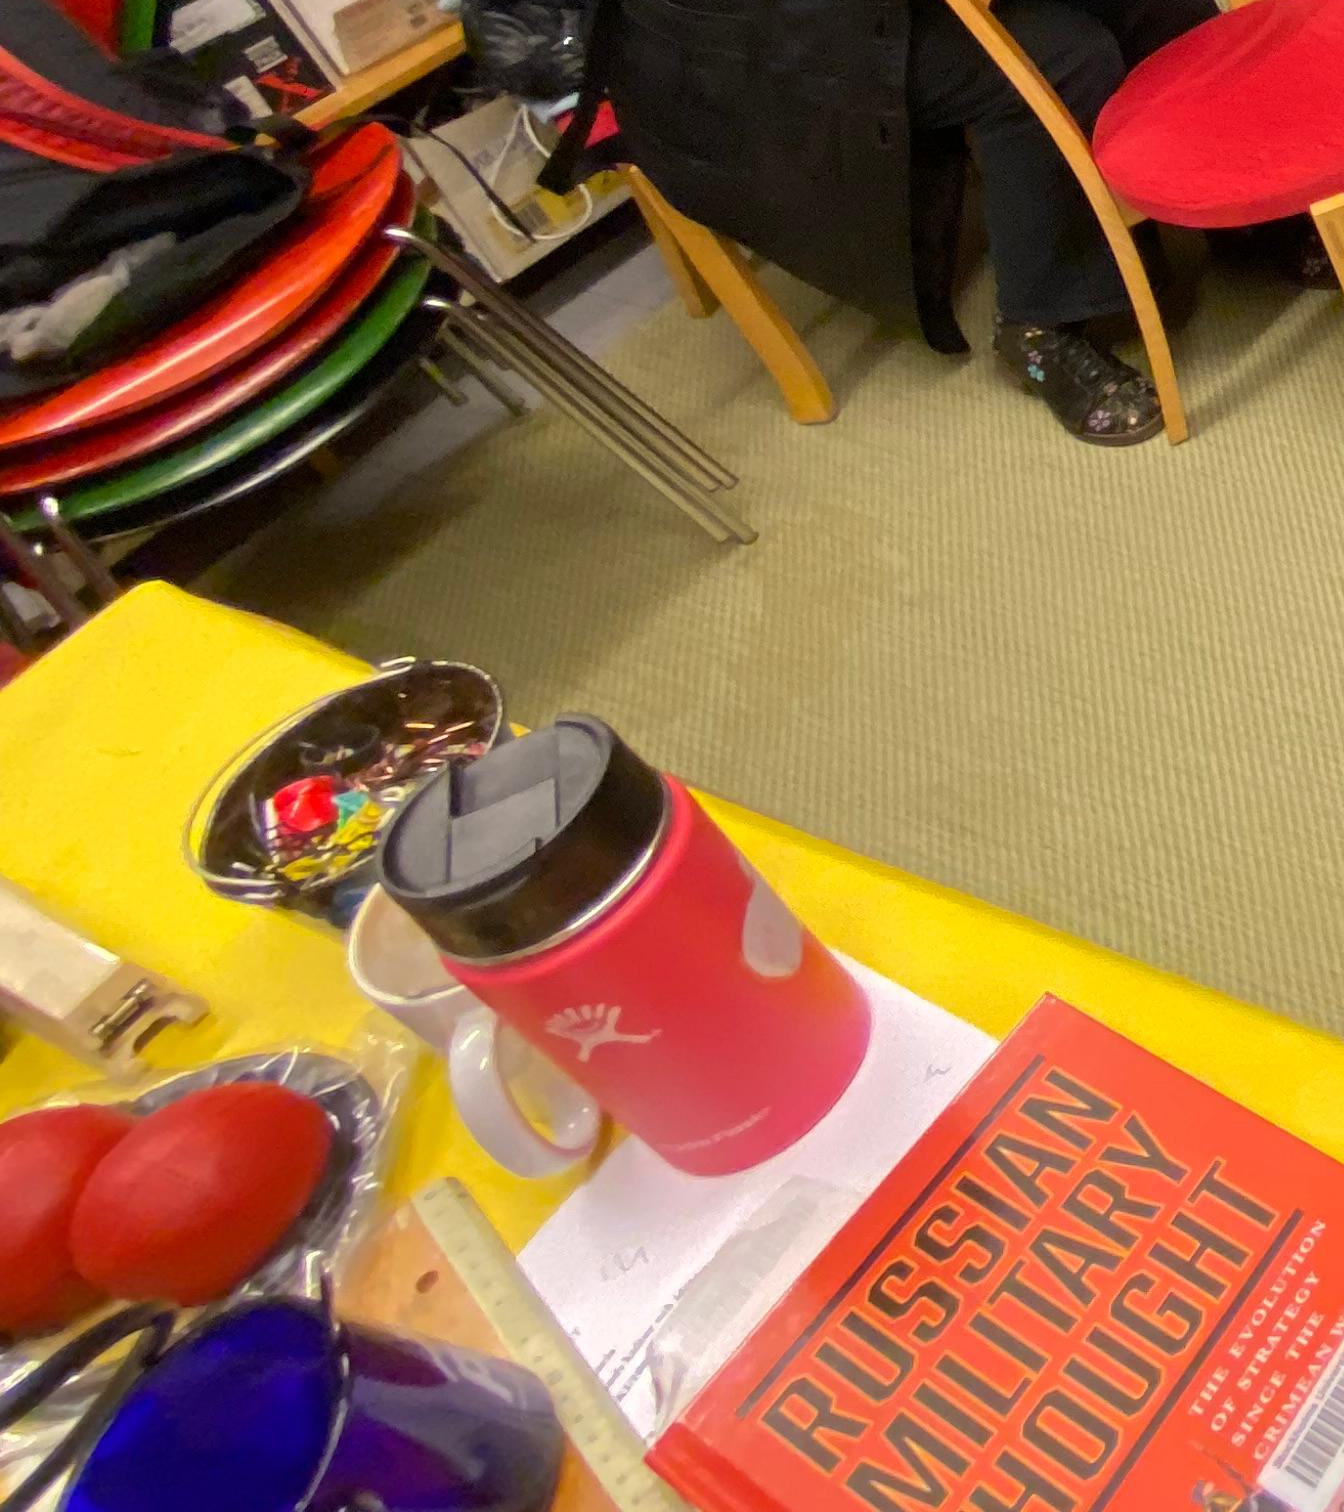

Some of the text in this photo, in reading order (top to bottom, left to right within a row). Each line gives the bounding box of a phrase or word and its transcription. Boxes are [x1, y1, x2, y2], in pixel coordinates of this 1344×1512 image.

[759, 1065, 1122, 1477] RUSSIAN
[843, 1110, 1190, 1512] MILITARY
[960, 1157, 1280, 1512] HOUGHT
[1187, 1218, 1327, 1418] THE EVOLUTION
[1209, 1270, 1321, 1432] OF STRATEGY
[1230, 1311, 1326, 1448] SINCE THE
[1252, 1344, 1334, 1461] CRIMEAN
